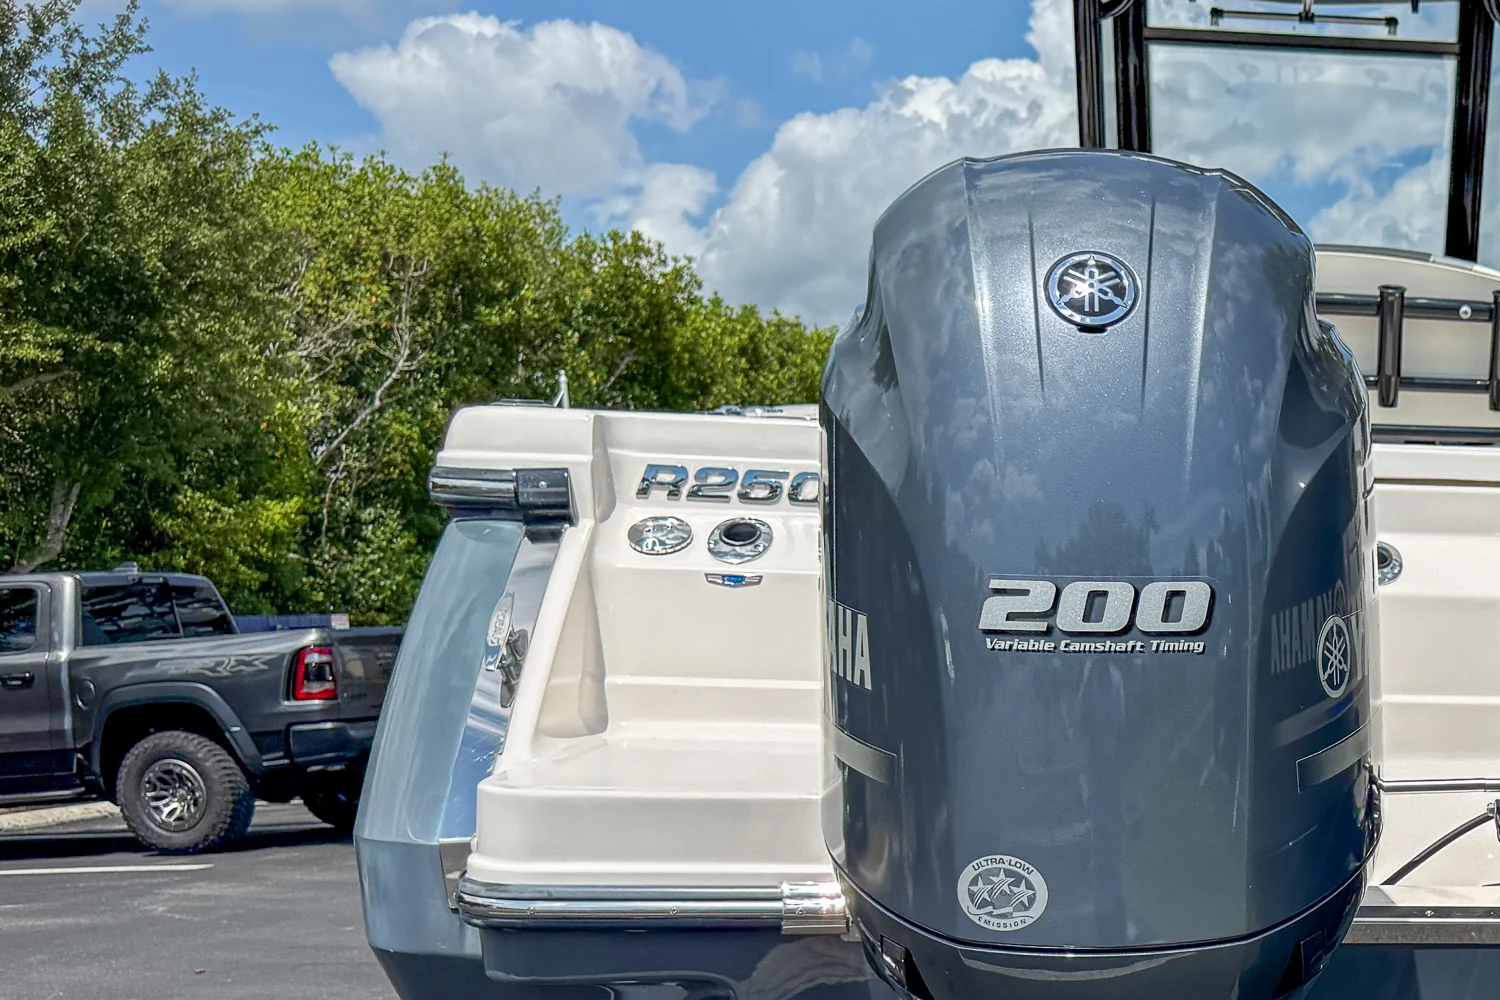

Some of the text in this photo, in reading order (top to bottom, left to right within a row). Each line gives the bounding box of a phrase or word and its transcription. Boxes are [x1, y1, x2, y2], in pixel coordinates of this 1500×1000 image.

[978, 579, 1213, 633] 200
[985, 637, 1205, 654] Variable Camshaft Timing
[977, 915, 1027, 929] EMISSION
